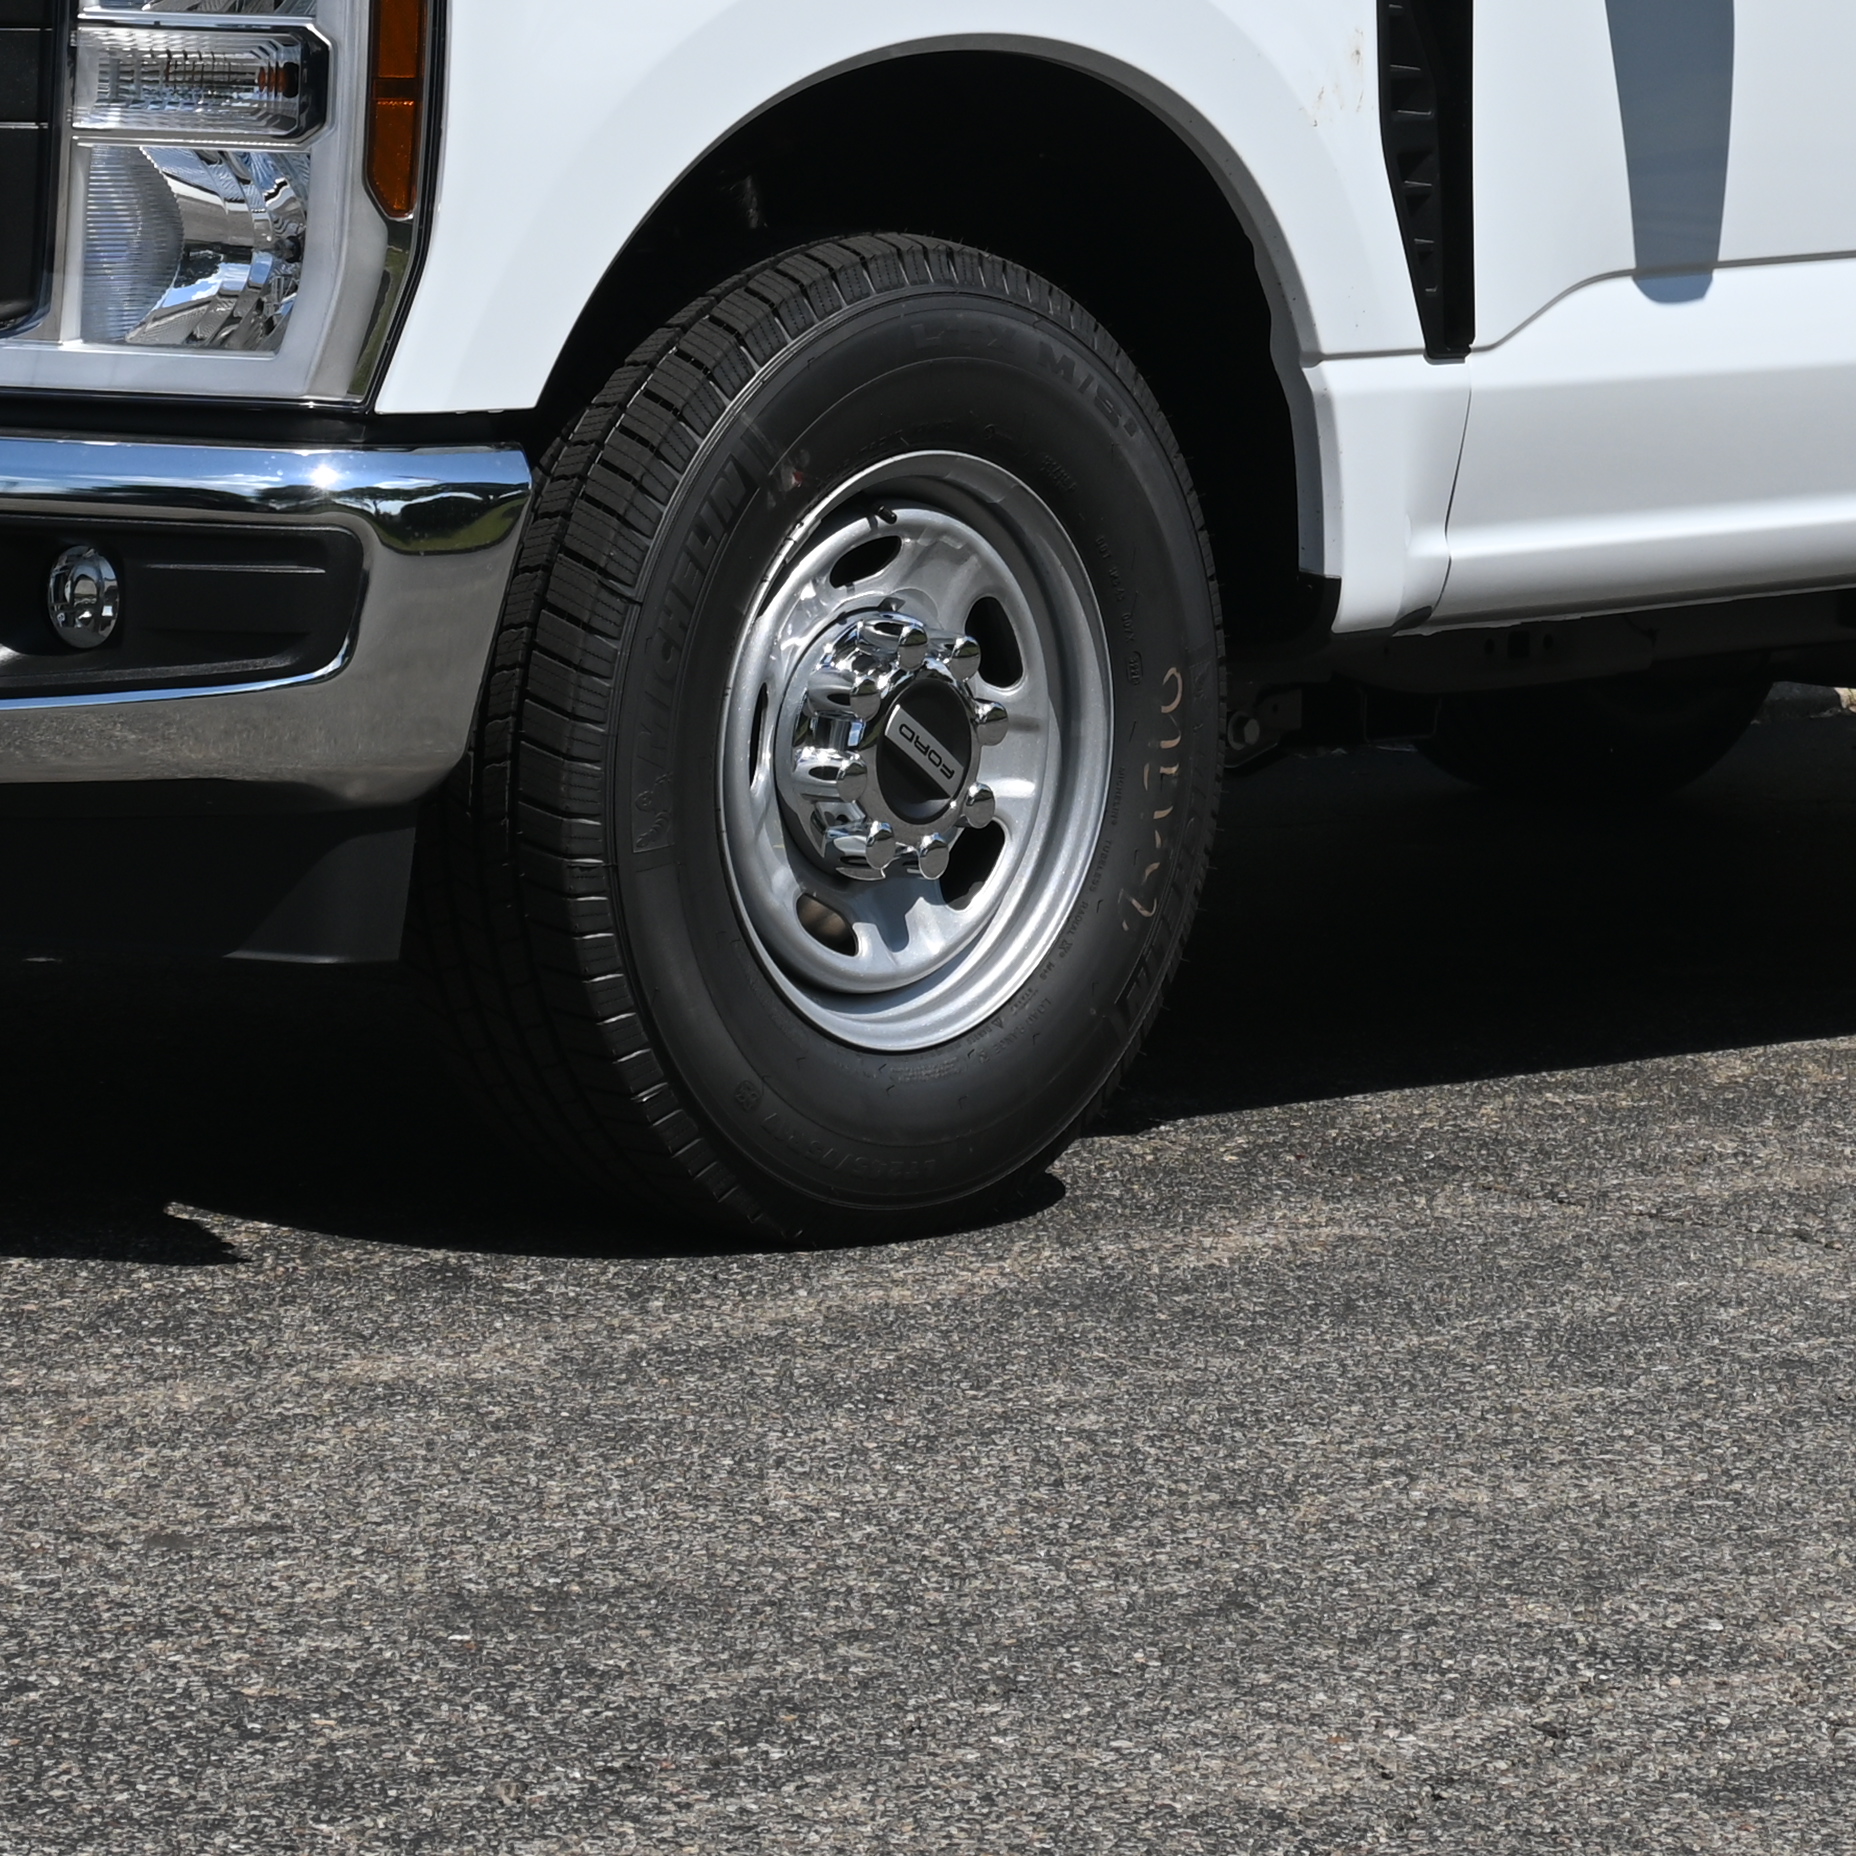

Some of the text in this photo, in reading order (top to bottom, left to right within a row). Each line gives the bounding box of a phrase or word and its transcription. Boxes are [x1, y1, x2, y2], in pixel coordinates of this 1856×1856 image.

[637, 453, 748, 772] MICHELIN
[899, 723, 955, 780] FORD
[1088, 839, 1112, 892] TUBELESS
[1066, 901, 1089, 937] RADIAL
